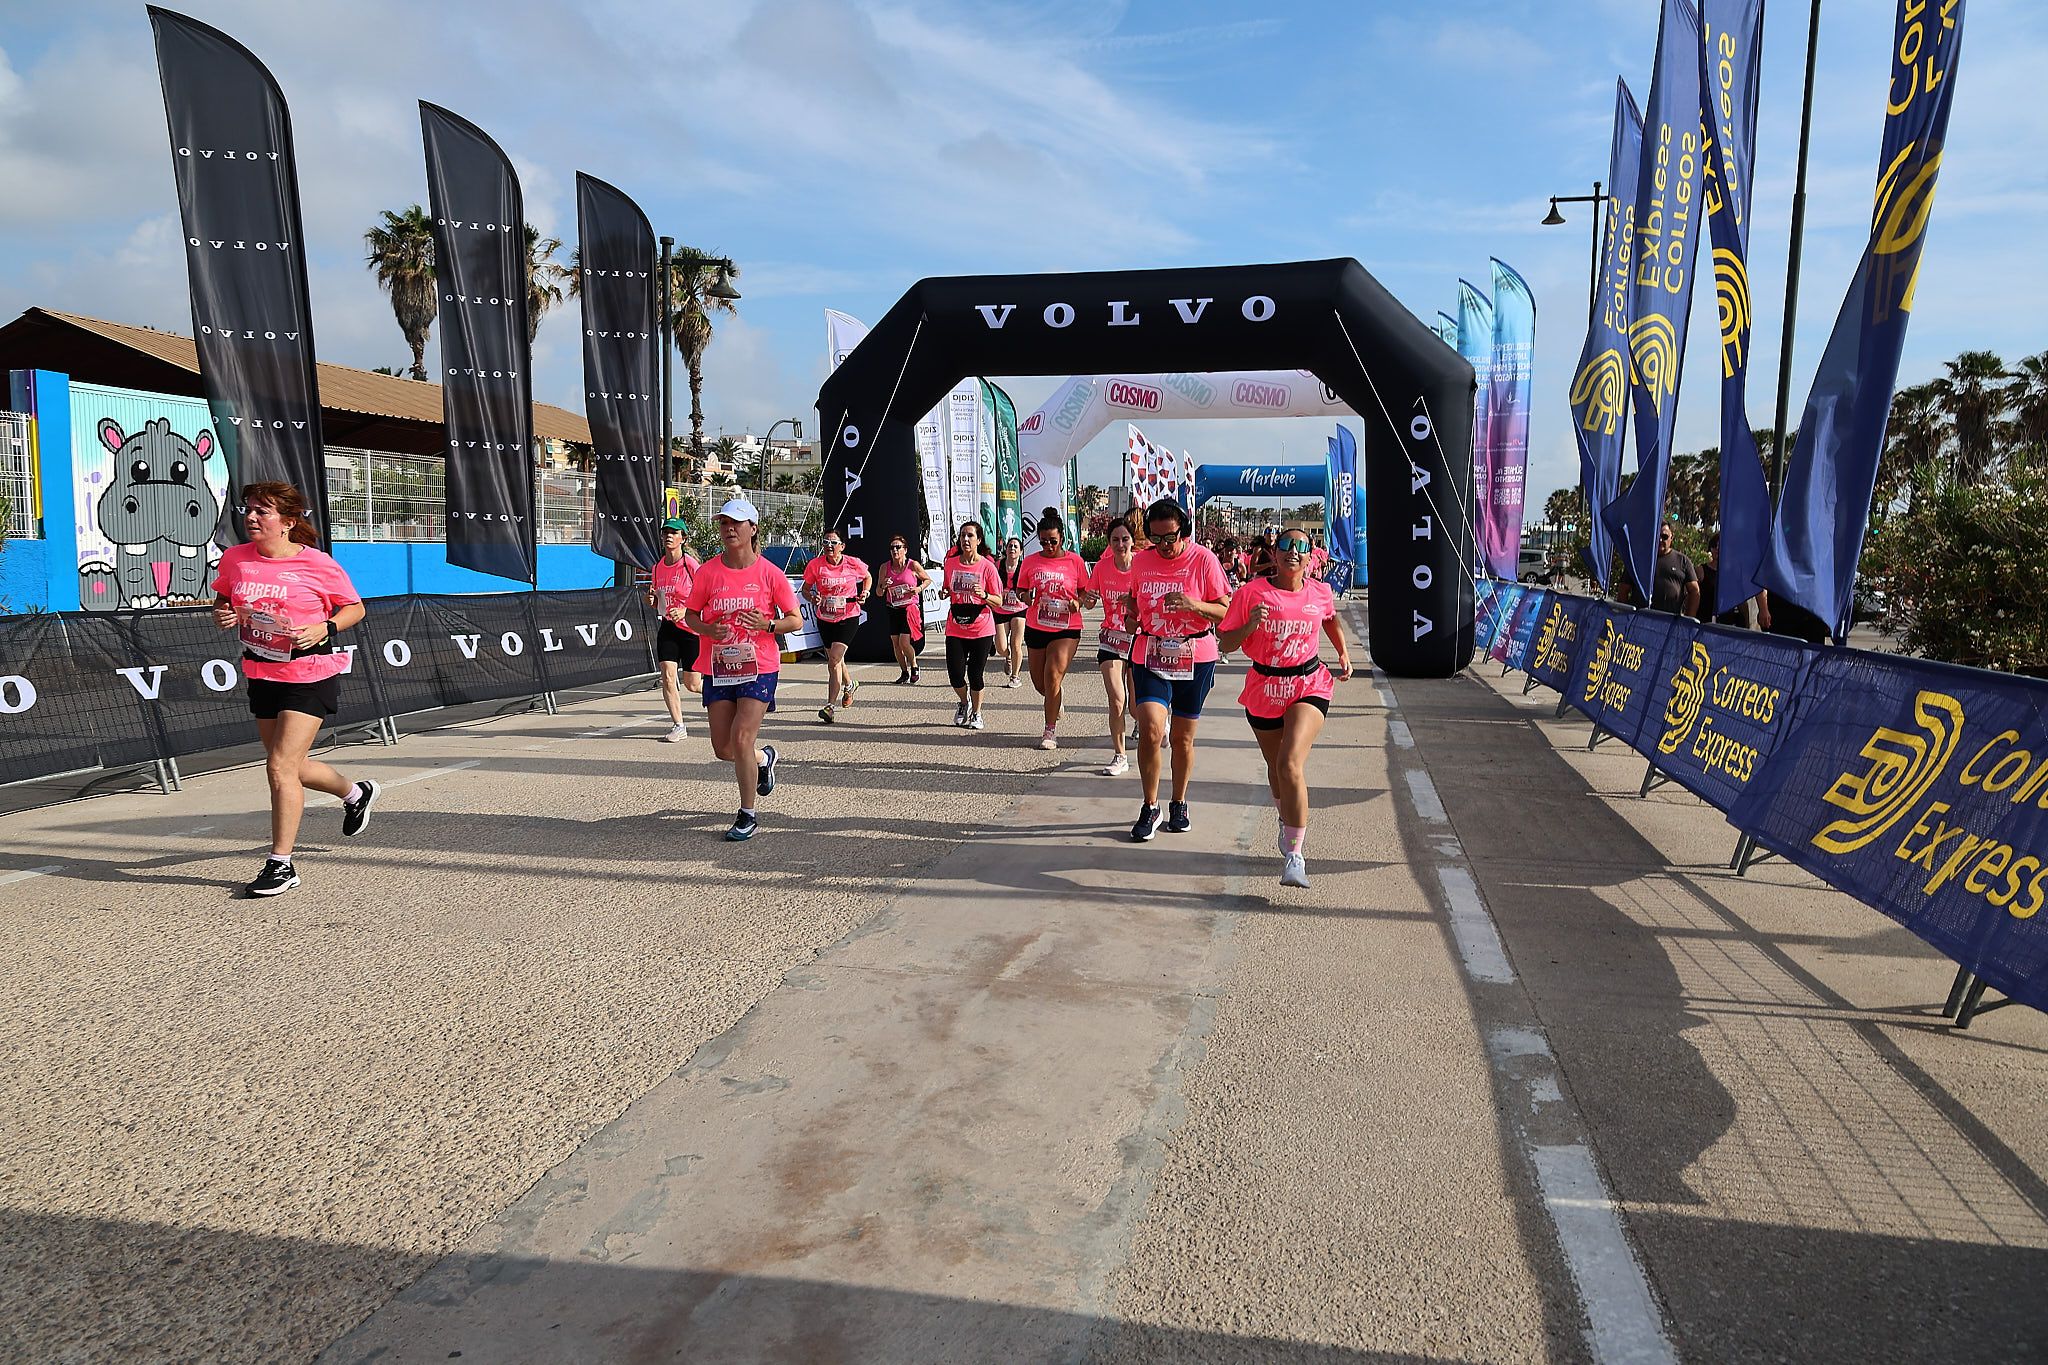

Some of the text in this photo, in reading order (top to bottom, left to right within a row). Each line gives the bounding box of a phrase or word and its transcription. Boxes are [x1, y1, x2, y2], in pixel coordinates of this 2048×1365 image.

[974, 295, 1276, 329] VOLVO
[1110, 382, 1158, 409] COSMO
[1235, 382, 1286, 408] COSMO
[1239, 467, 1297, 493] Marlene
[1410, 414, 1433, 642] VOLVO
[1034, 572, 1065, 581] CARRERA
[1141, 581, 1185, 594] CARRERA
[234, 581, 288, 600] CARRERA
[713, 597, 755, 611] CARRERA
[252, 629, 273, 642] 016
[451, 618, 634, 659] VOLVO
[1107, 636, 1121, 645] 016
[1264, 620, 1313, 635] CARRERA
[116, 639, 412, 700] VOVO
[725, 662, 743, 671] 016
[1160, 656, 1179, 665] 016
[1713, 665, 1780, 724] Correos
[1692, 716, 1758, 782] Express
[1894, 800, 2048, 920] Express
